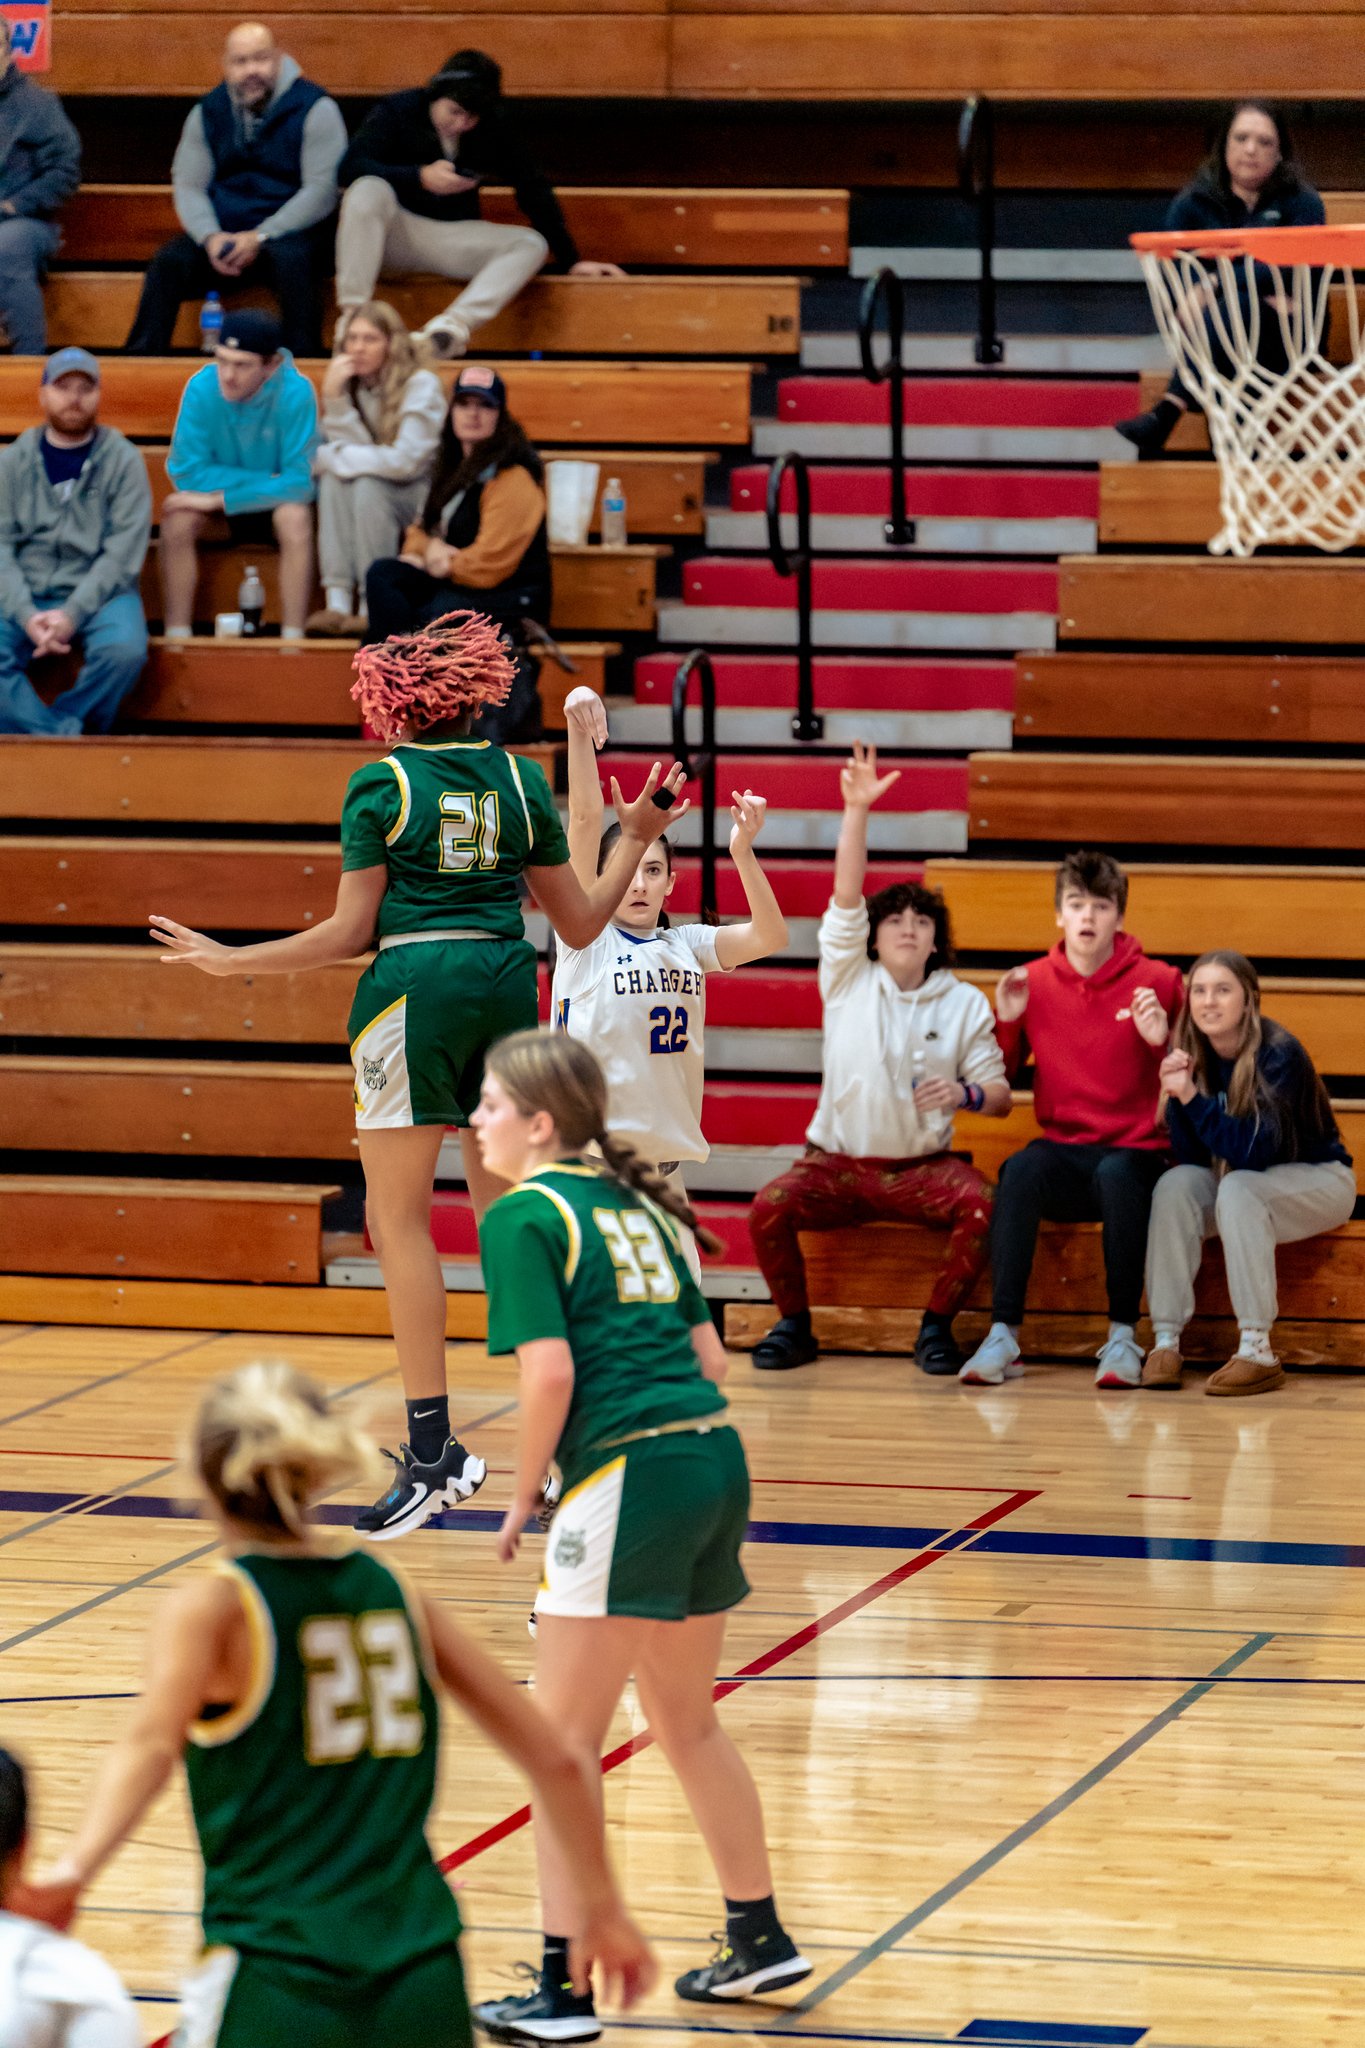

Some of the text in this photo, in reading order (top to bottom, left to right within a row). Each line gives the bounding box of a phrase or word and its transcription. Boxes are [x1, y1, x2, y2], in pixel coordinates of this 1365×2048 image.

[438, 790, 500, 872] 21
[649, 1005, 689, 1055] 22
[592, 1206, 680, 1304] 33
[297, 1608, 426, 1767] 22
